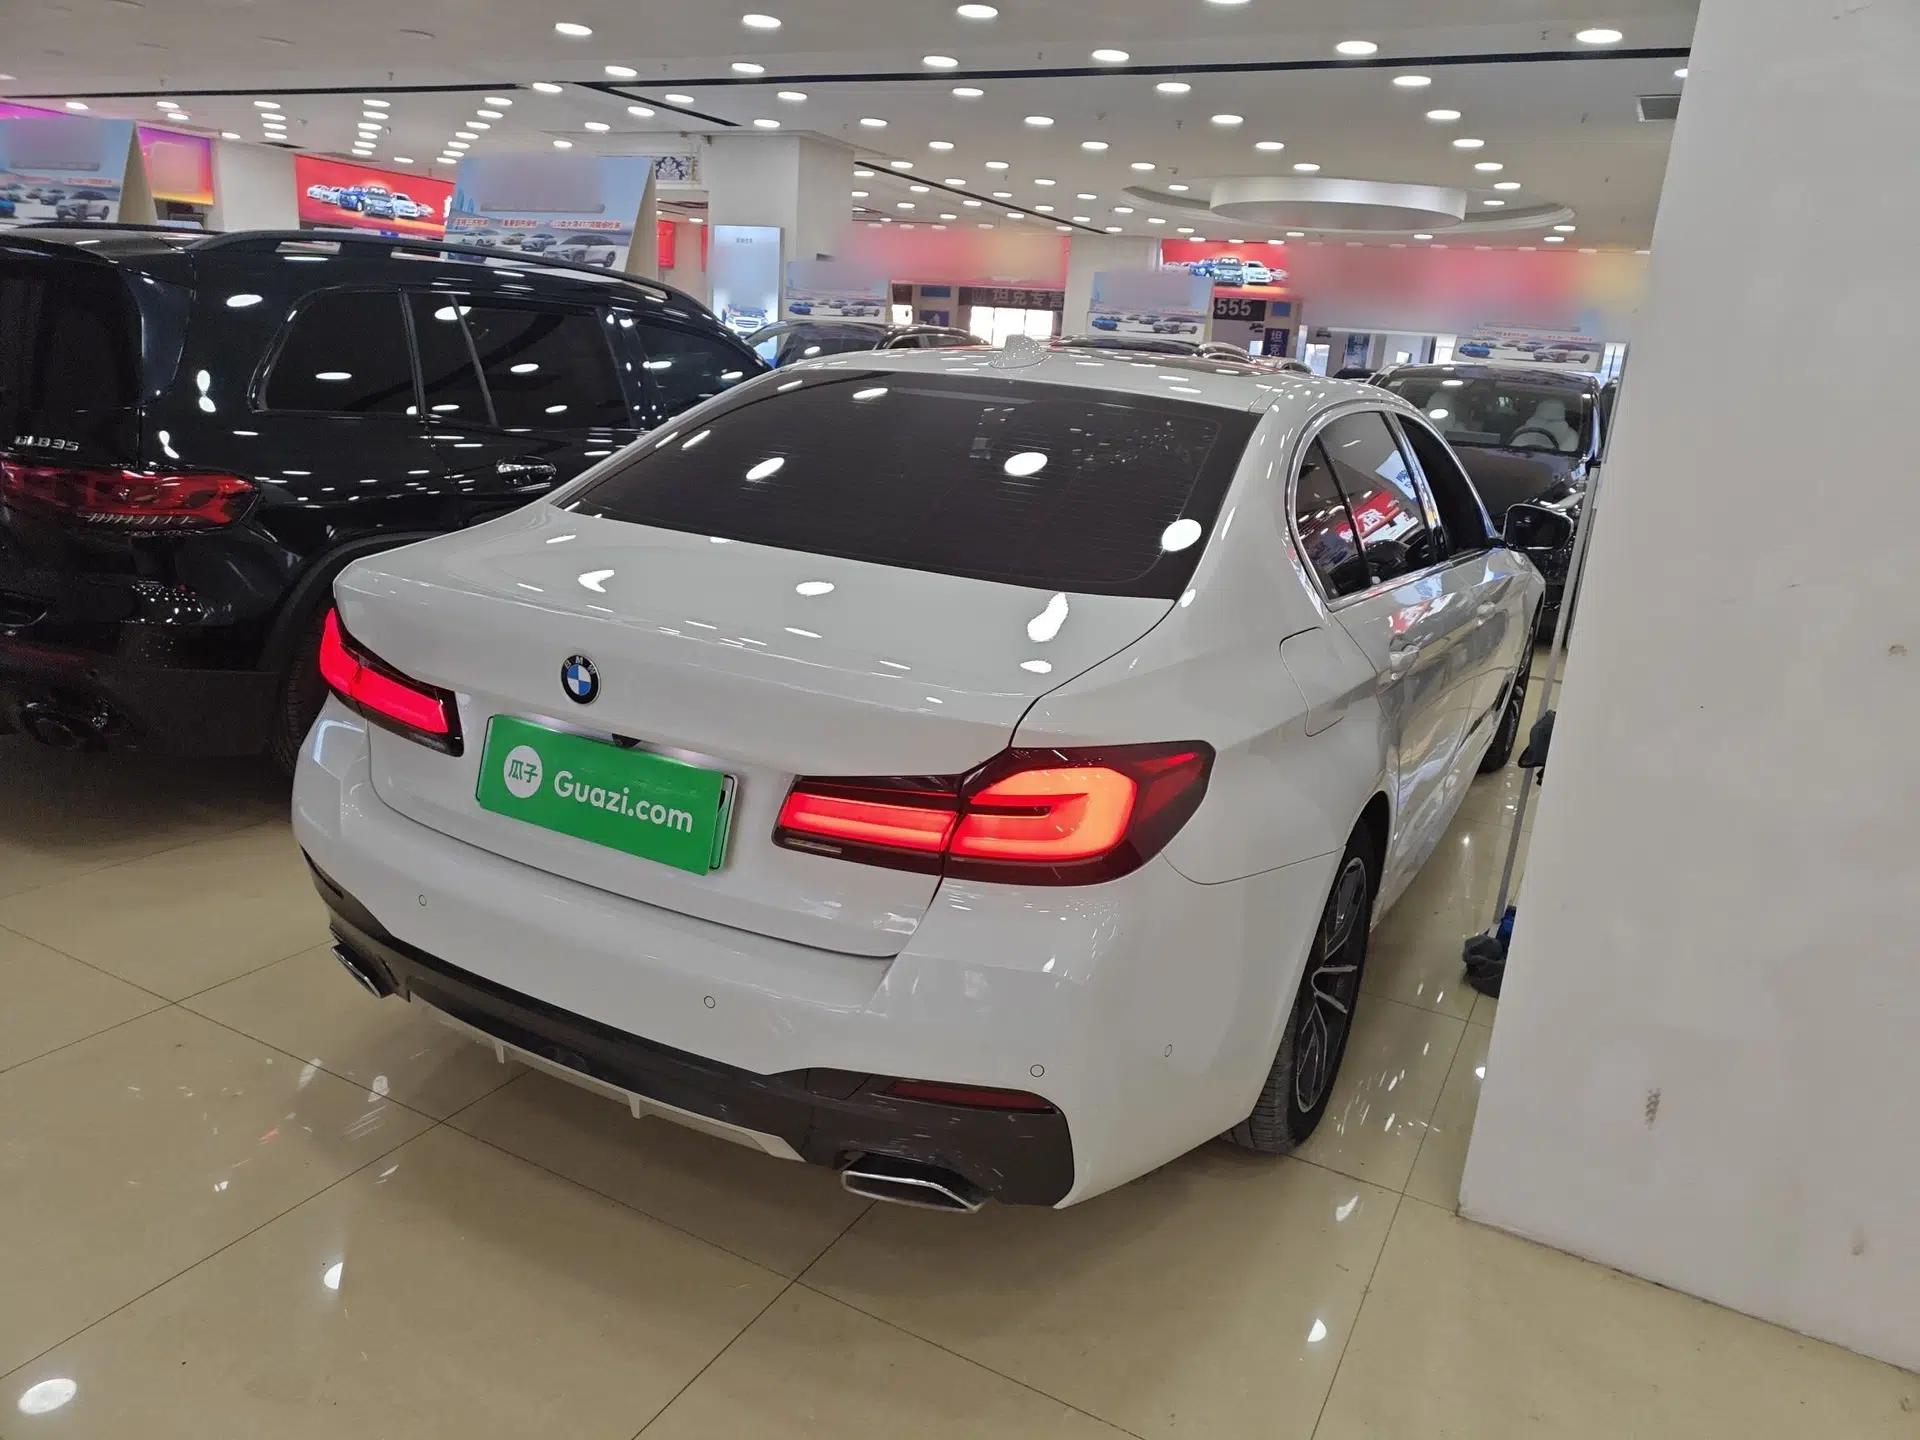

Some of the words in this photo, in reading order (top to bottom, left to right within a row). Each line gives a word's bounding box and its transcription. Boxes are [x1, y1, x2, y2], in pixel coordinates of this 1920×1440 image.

[564, 655, 596, 675] BMW
[508, 759, 538, 784] 瓜子
[554, 770, 693, 833] Guazi.com
